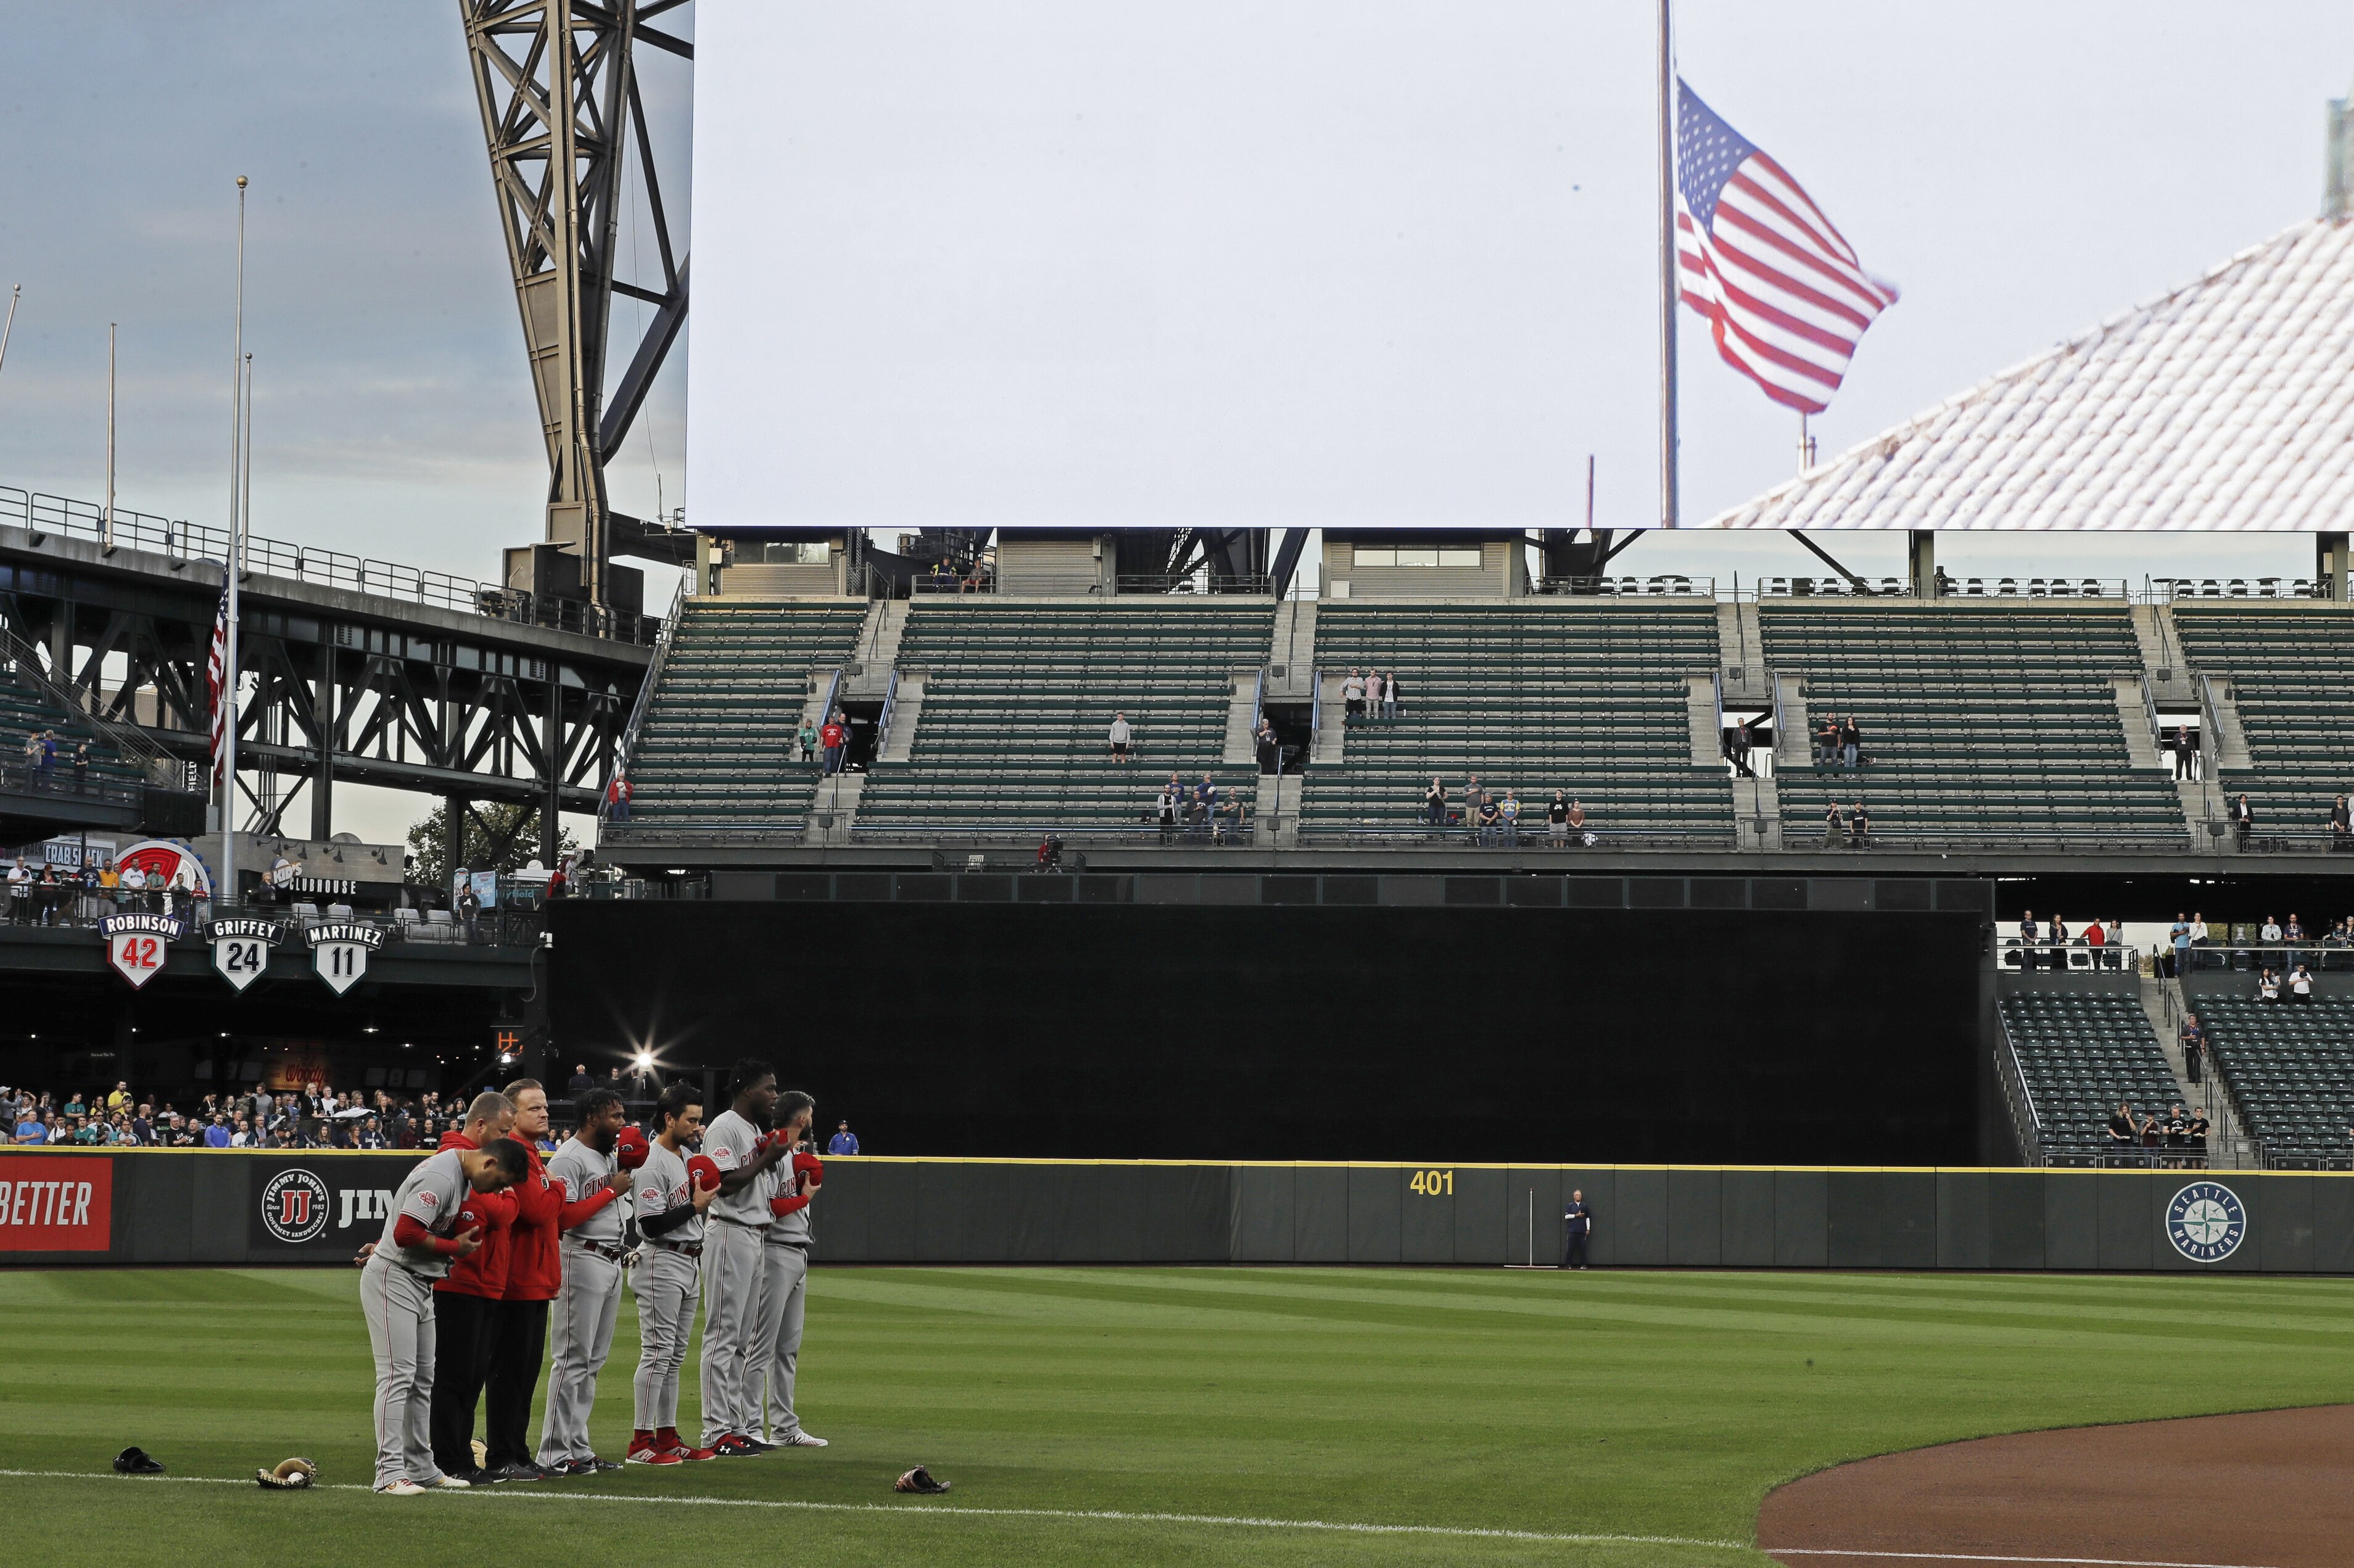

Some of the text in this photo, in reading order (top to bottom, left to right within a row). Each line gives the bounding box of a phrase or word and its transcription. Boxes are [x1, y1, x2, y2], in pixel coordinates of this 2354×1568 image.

[188, 761, 197, 792] FIELD
[44, 844, 70, 865] CRAB
[273, 860, 302, 885] KID'S
[289, 877, 356, 894] CLUBHOUSE
[106, 915, 179, 935] ROBINSON
[215, 920, 276, 938] GRIFFEY
[310, 925, 381, 945] MARTINEZ
[122, 937, 157, 968] 42
[226, 941, 260, 973] 24
[331, 946, 354, 976] 11
[266, 1174, 324, 1202] JIMMY JOHN'S
[1410, 1170, 1453, 1195] 401
[0, 1181, 92, 1226] BETTER
[280, 1190, 312, 1224] JJ
[2174, 1187, 2238, 1213] SEATTLE
[267, 1211, 324, 1237] GOURMET SANDWICHES
[2174, 1229, 2239, 1256] MARINERS
